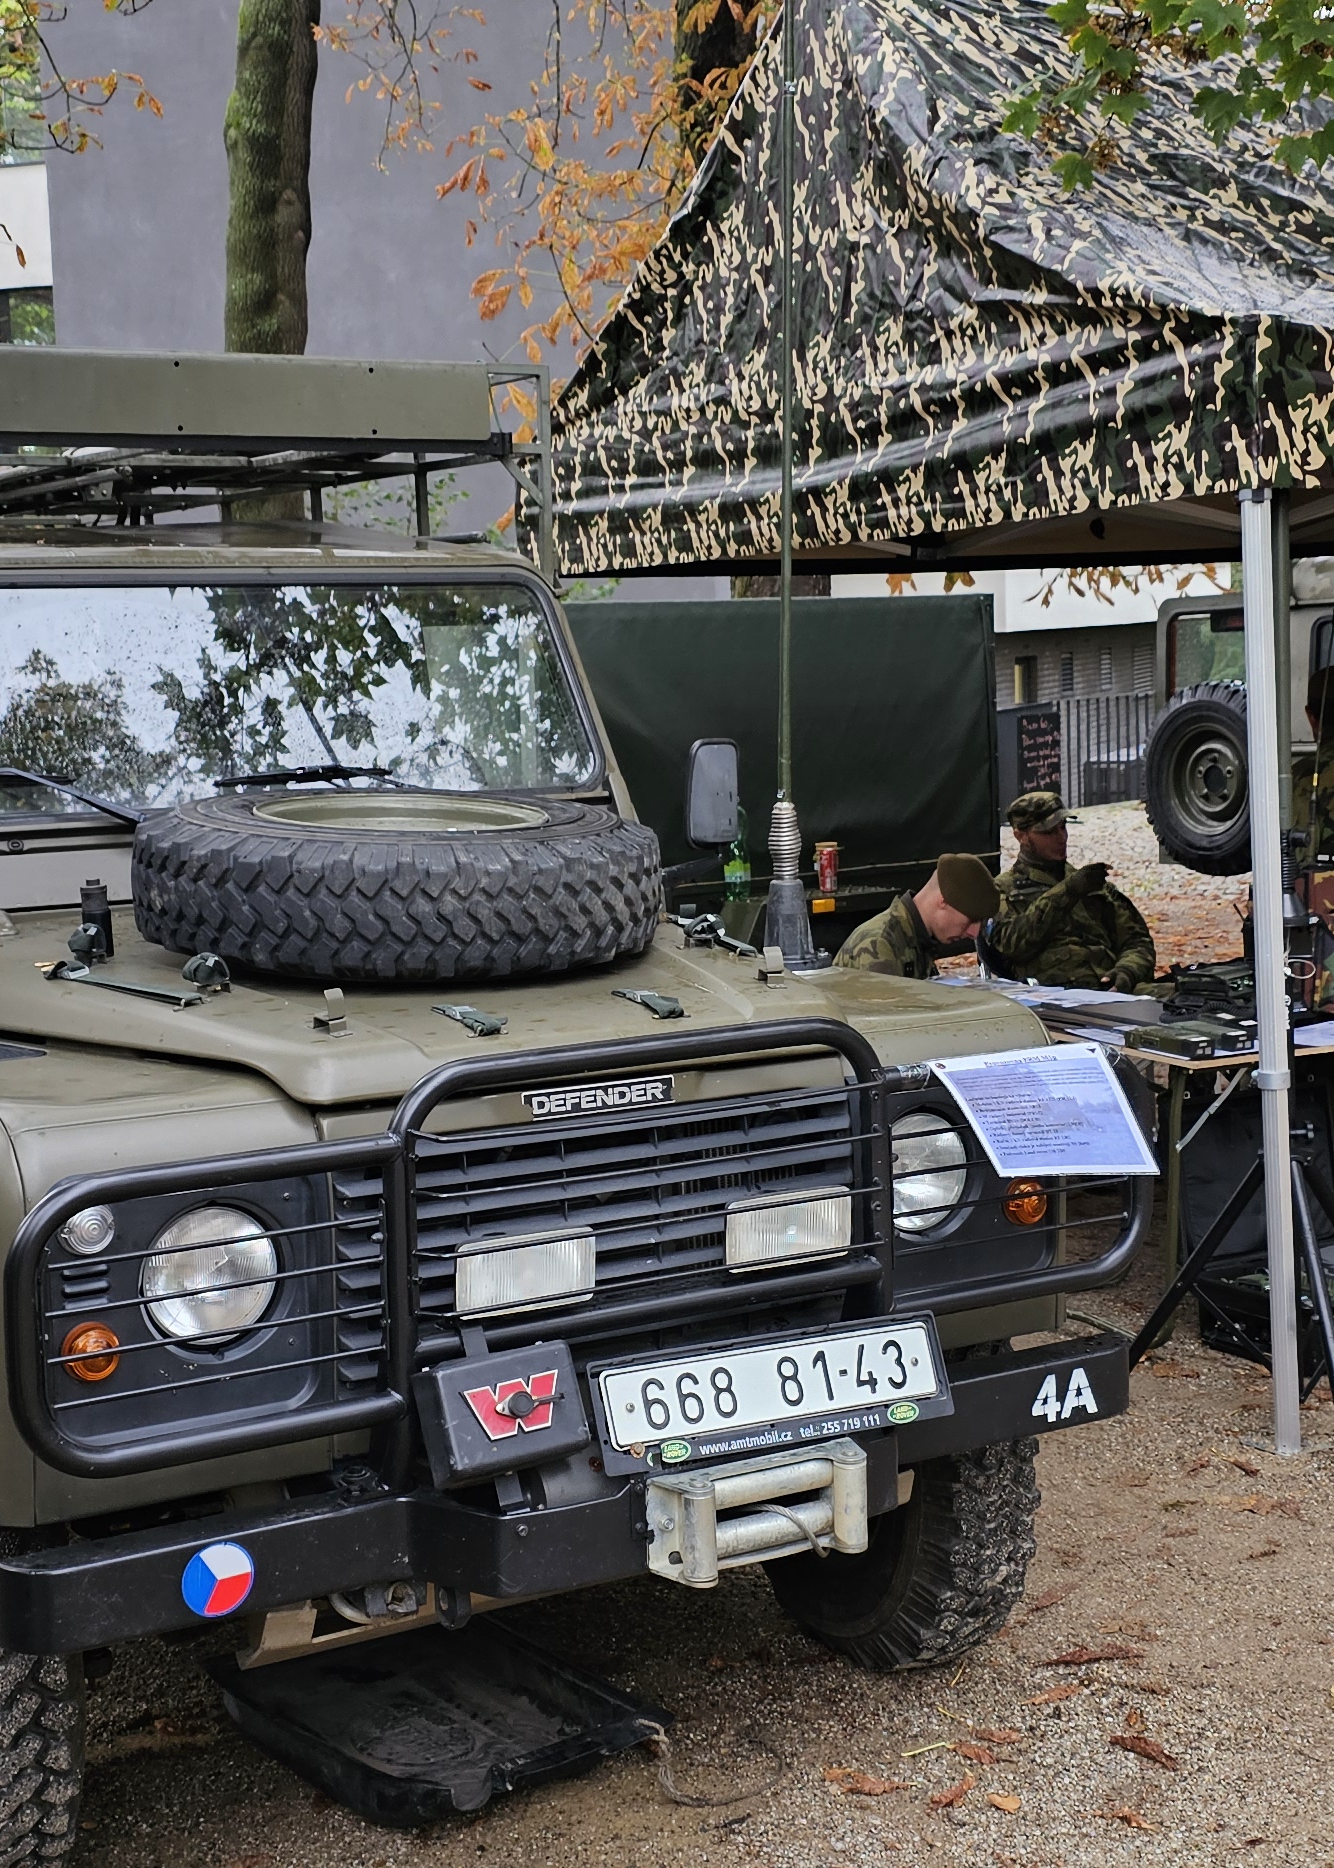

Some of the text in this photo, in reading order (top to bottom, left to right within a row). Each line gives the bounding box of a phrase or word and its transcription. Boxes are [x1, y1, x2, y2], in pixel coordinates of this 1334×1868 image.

[532, 1082, 665, 1115] DEFENDER
[463, 1369, 558, 1440] W
[641, 1339, 907, 1430] 668 81-43
[1032, 1367, 1098, 1423] 4A
[699, 1431, 793, 1455] www.amtmobil.cz
[821, 1421, 840, 1435] 255
[841, 1417, 860, 1431] 719
[862, 1413, 881, 1427] 111
